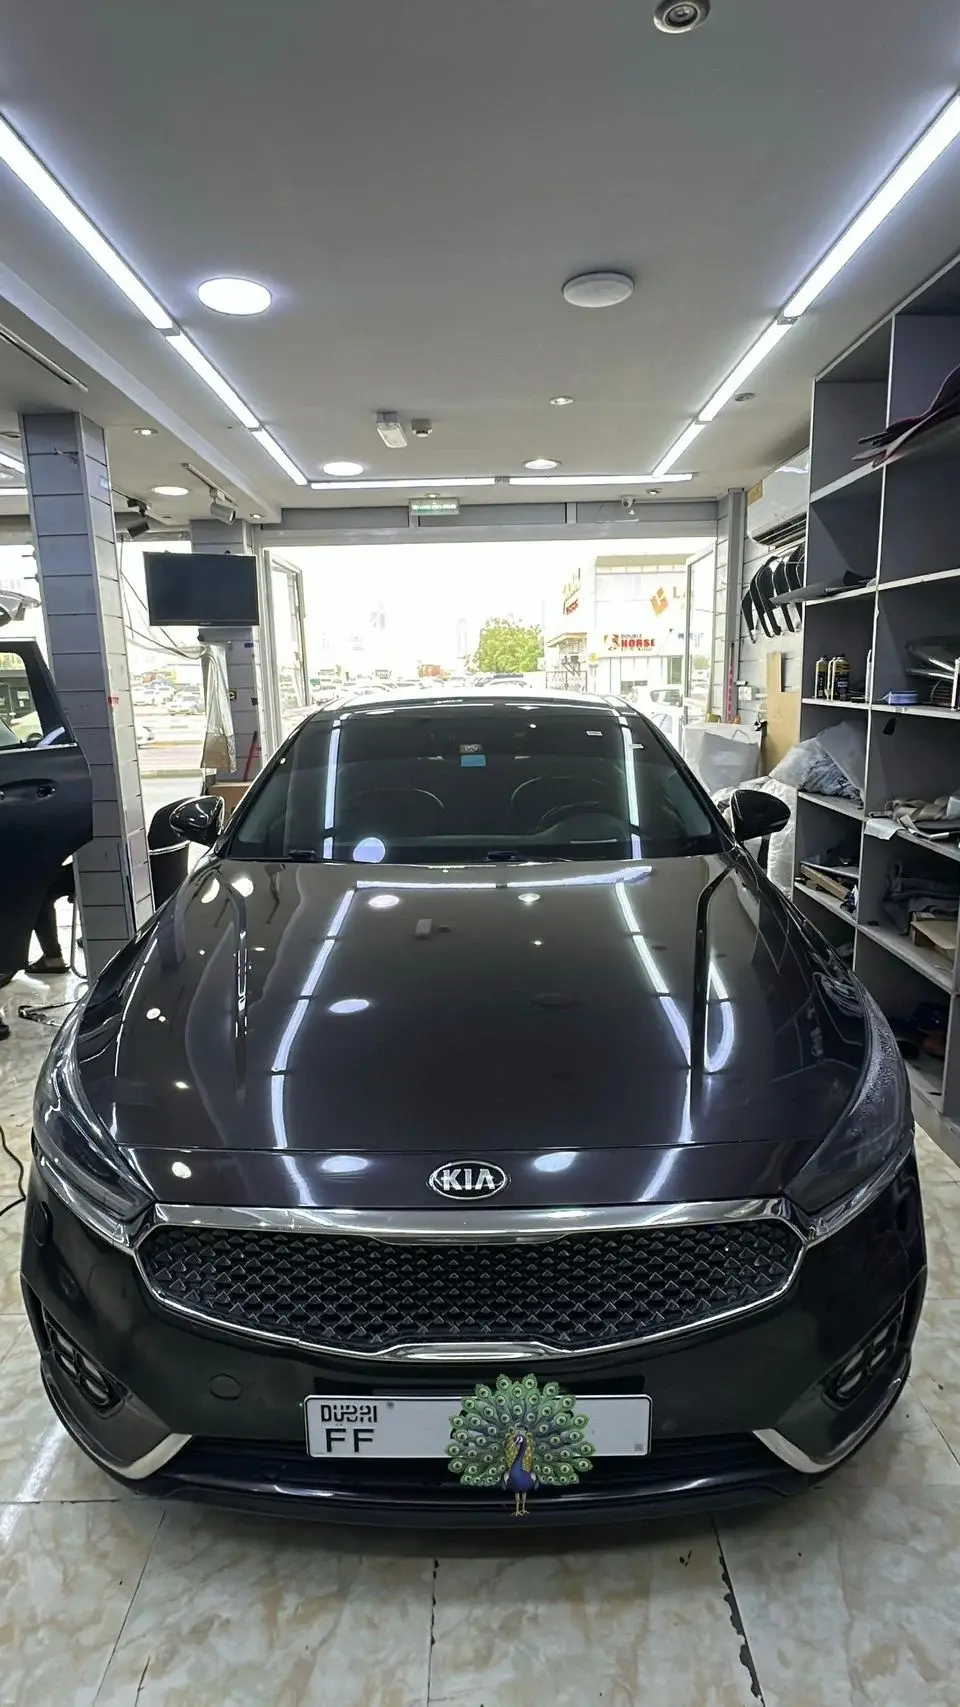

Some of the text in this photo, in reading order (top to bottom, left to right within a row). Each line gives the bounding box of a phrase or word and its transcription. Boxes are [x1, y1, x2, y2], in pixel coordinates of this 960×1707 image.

[621, 638, 656, 648] HORSE
[441, 1168, 496, 1191] KIA
[320, 1404, 378, 1423] DUBAI
[325, 1428, 374, 1453] FF
